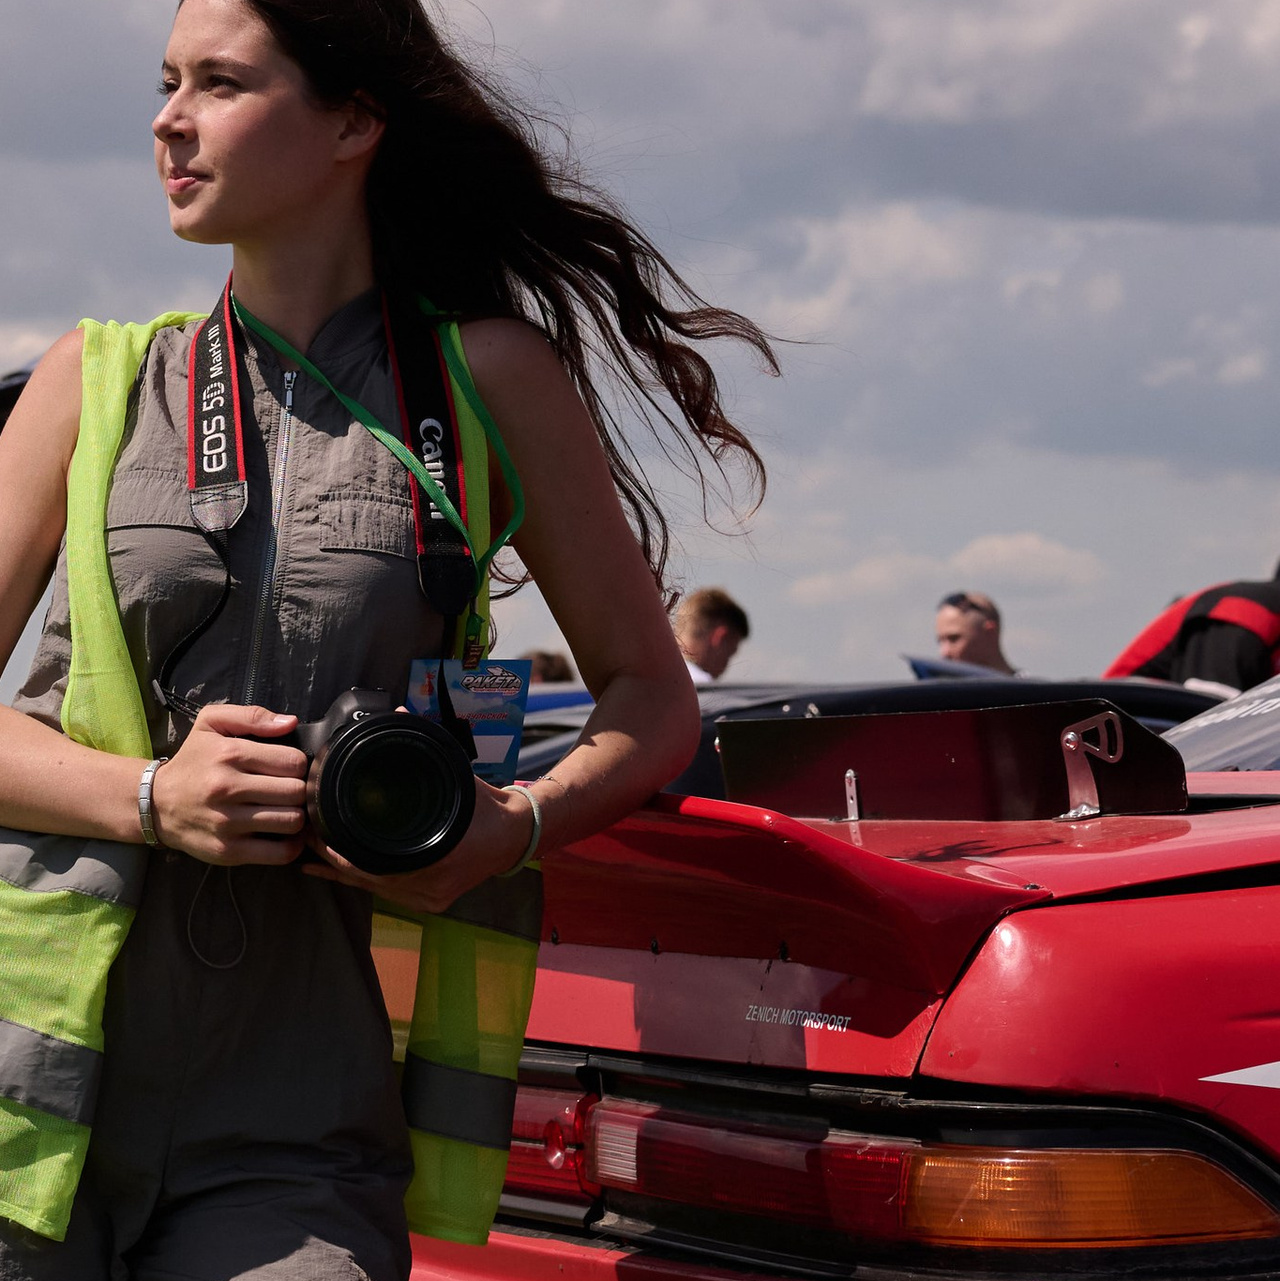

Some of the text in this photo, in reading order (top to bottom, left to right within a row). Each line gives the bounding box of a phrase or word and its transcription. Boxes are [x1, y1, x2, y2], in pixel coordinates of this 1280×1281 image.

[209, 341, 224, 379] Mark
[202, 381, 225, 412] 5D
[202, 415, 228, 473] EOS
[745, 1005, 852, 1033] ZENICH MOTORSPORT
